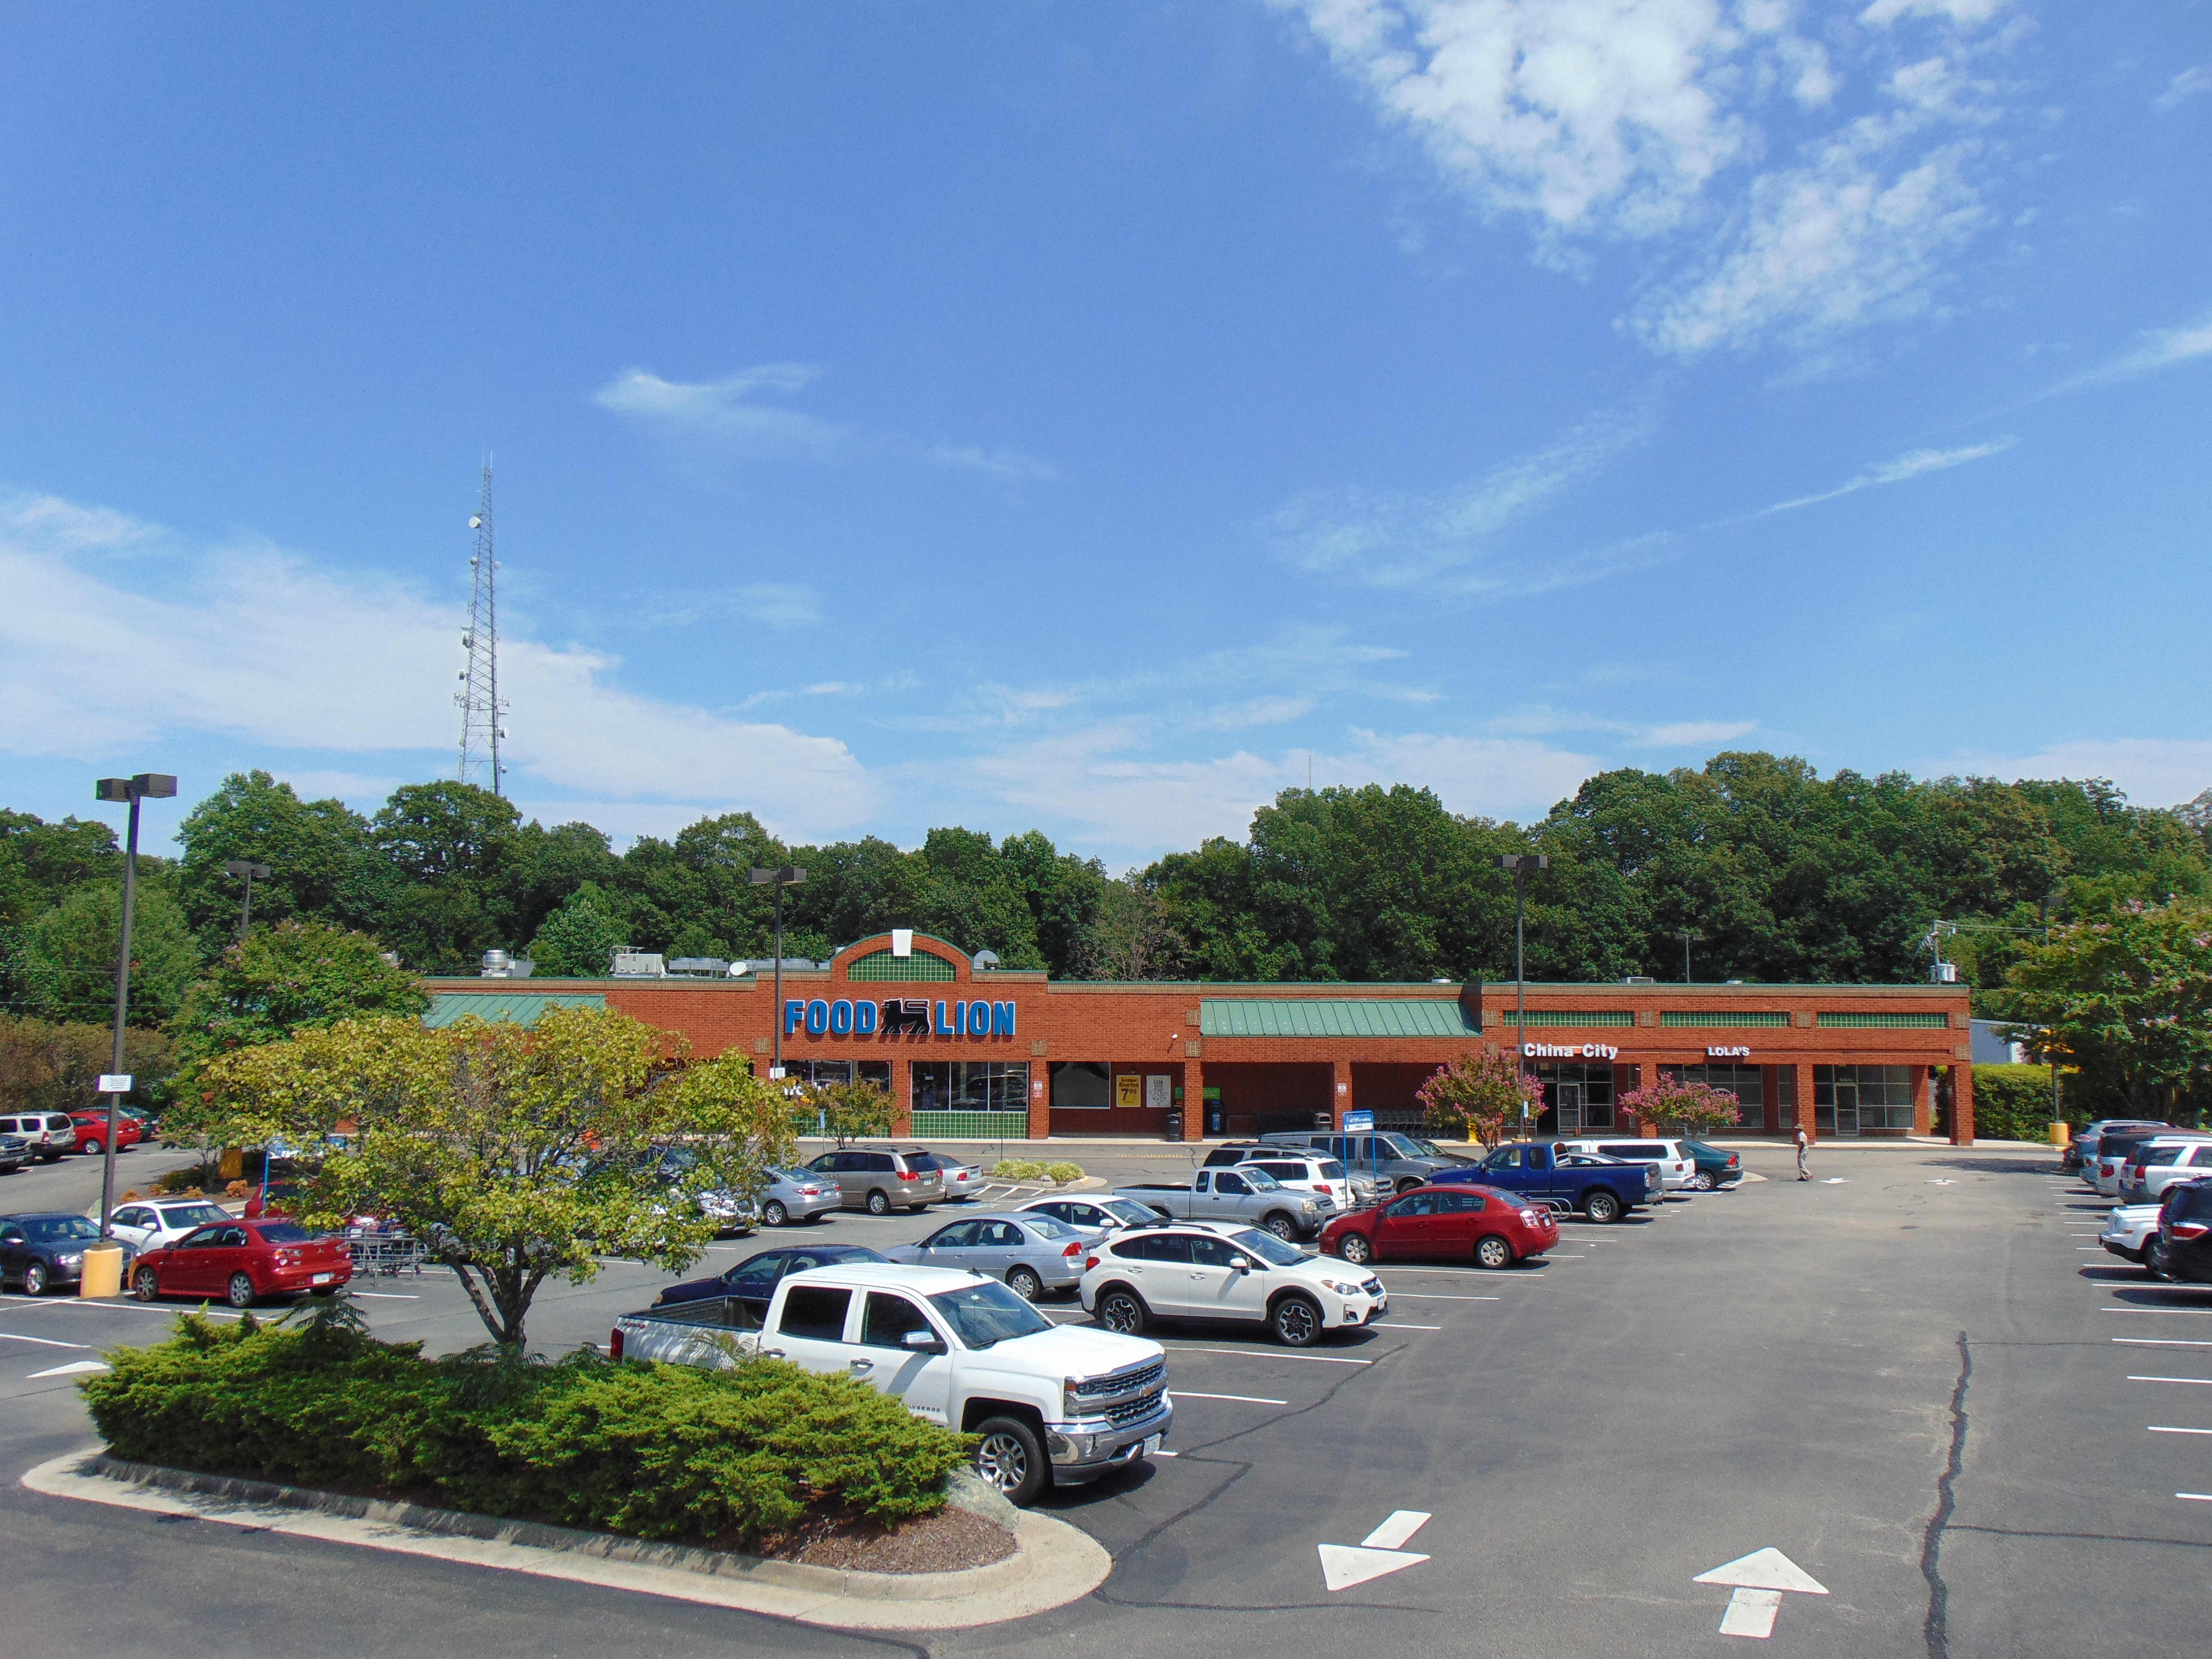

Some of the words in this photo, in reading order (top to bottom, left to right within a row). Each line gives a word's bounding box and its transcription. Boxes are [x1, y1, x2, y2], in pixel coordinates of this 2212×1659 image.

[785, 999, 877, 1034] FOOD
[936, 1000, 1015, 1035] LION
[1525, 1042, 1574, 1057] China
[1582, 1043, 1618, 1060] City
[1708, 1046, 1750, 1056] LOLA'S
[902, 1404, 941, 1412] LVERADO
